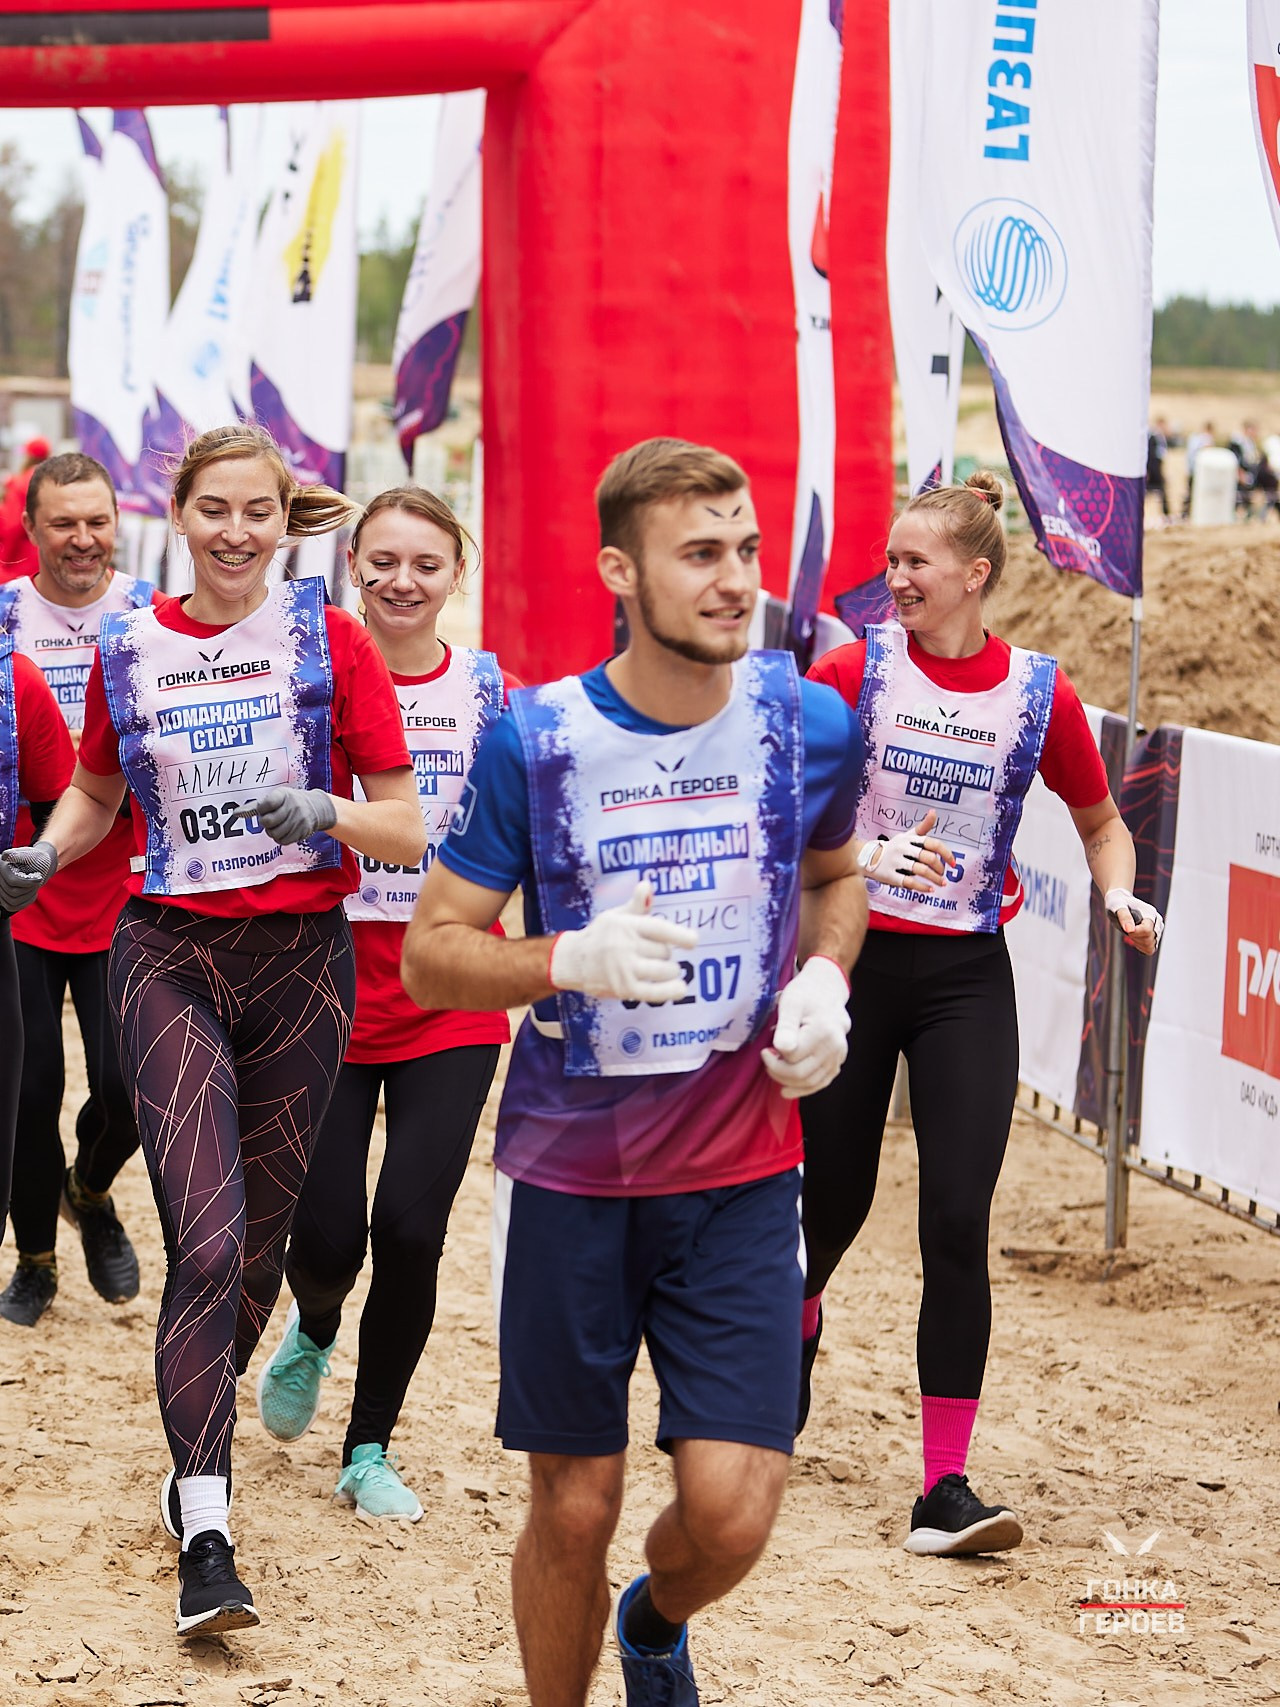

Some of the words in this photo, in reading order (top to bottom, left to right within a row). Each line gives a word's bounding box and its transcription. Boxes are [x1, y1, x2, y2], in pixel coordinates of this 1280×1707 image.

[35, 638, 73, 648] ГОНКА
[44, 667, 90, 686] ОМАНД
[157, 670, 208, 688] ГОНКА
[211, 660, 271, 679] ГЕРОЕВ
[60, 686, 86, 703] СТА
[160, 695, 279, 733] КОМАНДНЫЙ
[407, 716, 457, 728] ГЕРОЕВ
[896, 713, 941, 733] ГОНКА
[944, 724, 997, 743] ГЕРОЕВ
[192, 724, 249, 749] СТАРТ
[177, 757, 277, 794] АЛИНА
[884, 749, 992, 788] КОМАНДНЫЙ
[600, 784, 664, 806] ГОНКА
[670, 775, 739, 795] ГЕРОЕВ
[909, 779, 960, 803] СТАРТ
[180, 798, 265, 844] 0320
[212, 845, 283, 873] ГАЗПРОМБАНК
[601, 825, 748, 869] КОМАНДНЫЙ
[642, 863, 710, 893] СТАРТ
[888, 885, 958, 911] ГАЗПРОМБАНК
[622, 955, 741, 1010] 207
[652, 1027, 720, 1048] ГАЗПРОМ
